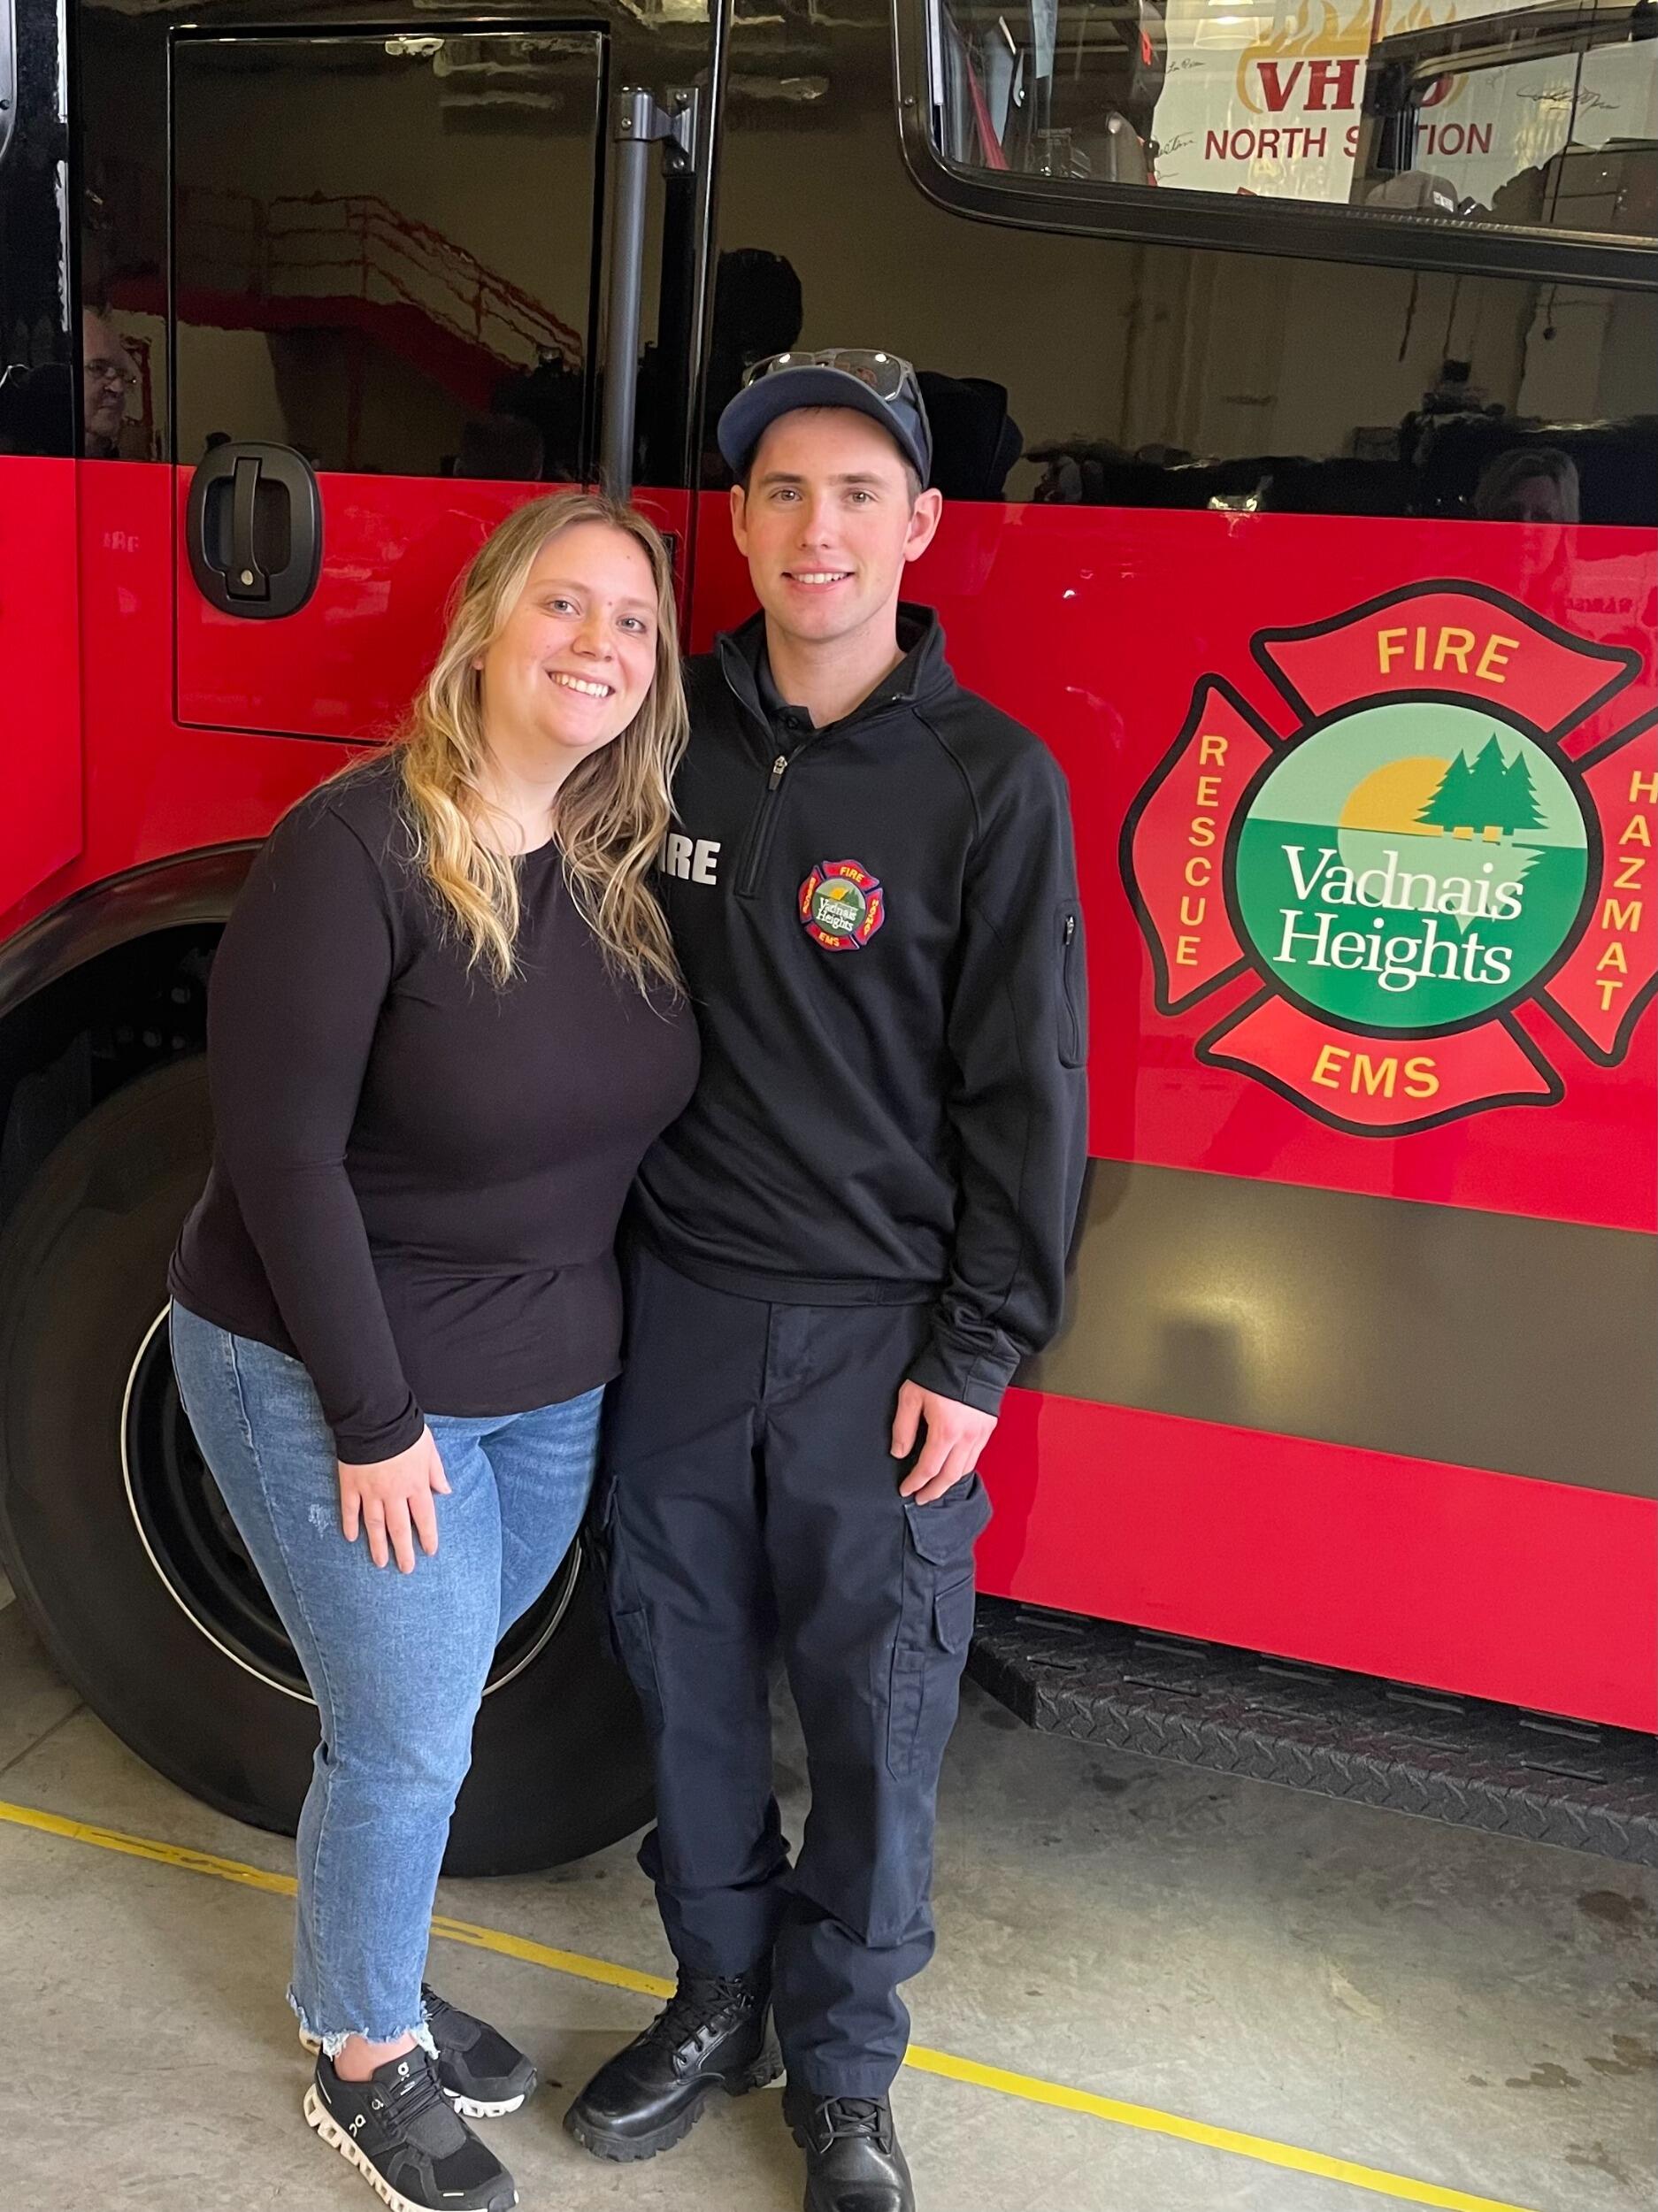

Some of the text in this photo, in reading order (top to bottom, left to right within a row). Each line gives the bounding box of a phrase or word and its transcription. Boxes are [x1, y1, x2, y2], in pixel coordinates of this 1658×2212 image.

[1204, 127, 1328, 160] NORTH
[1377, 626, 1520, 683] FIRE
[657, 830, 722, 886] IRE
[839, 865, 865, 883] FIRE
[1175, 735, 1229, 966] RESCUE
[819, 896, 859, 922] Vadnais
[1280, 844, 1524, 921] Vadnais
[1595, 770, 1658, 1011] HAZMAT
[816, 908, 855, 933] Heights
[818, 932, 841, 948] EMS
[1272, 909, 1514, 993] Heights
[1309, 1043, 1441, 1099] EMS
